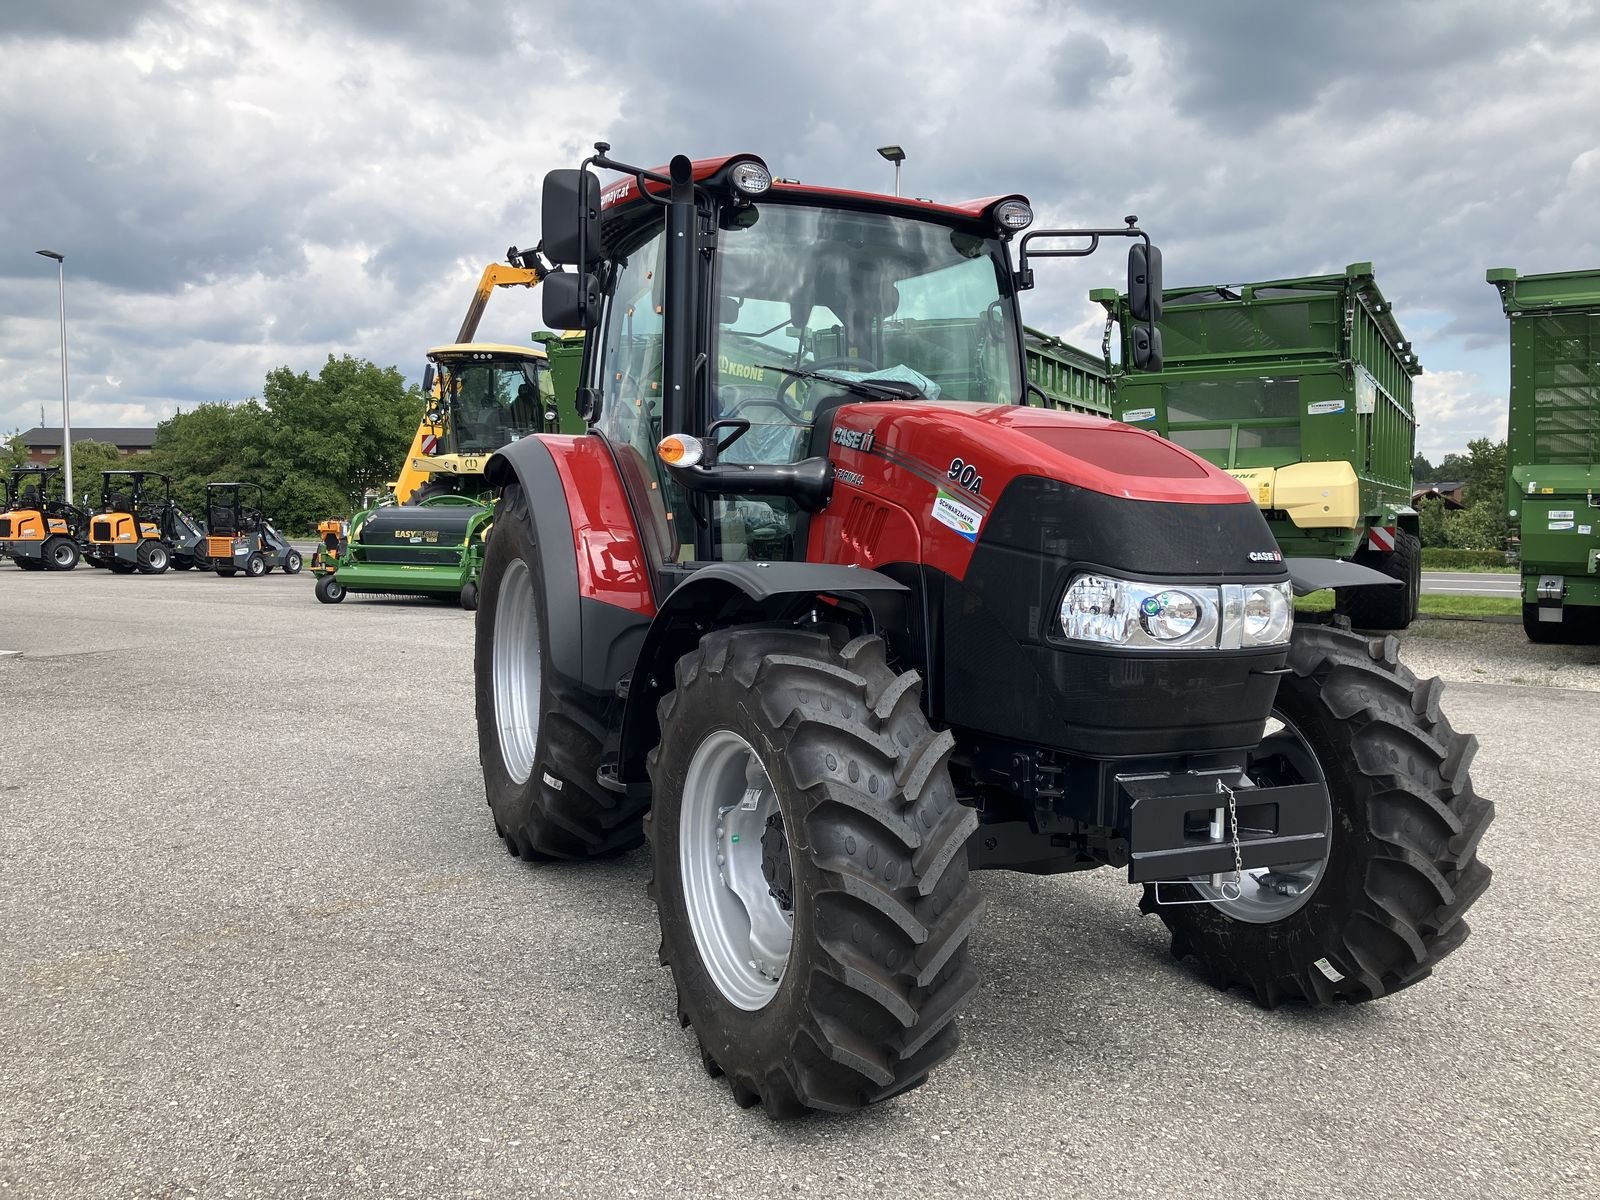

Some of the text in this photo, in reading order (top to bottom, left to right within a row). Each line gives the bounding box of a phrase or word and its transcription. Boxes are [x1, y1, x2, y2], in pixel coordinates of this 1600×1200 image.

[729, 362, 764, 381] KRONE
[833, 427, 862, 449] CASE
[836, 468, 865, 486] FARMALL
[948, 457, 983, 495] 90A
[939, 498, 974, 525] SCHWARZMAYR
[1249, 551, 1275, 561] CASE
